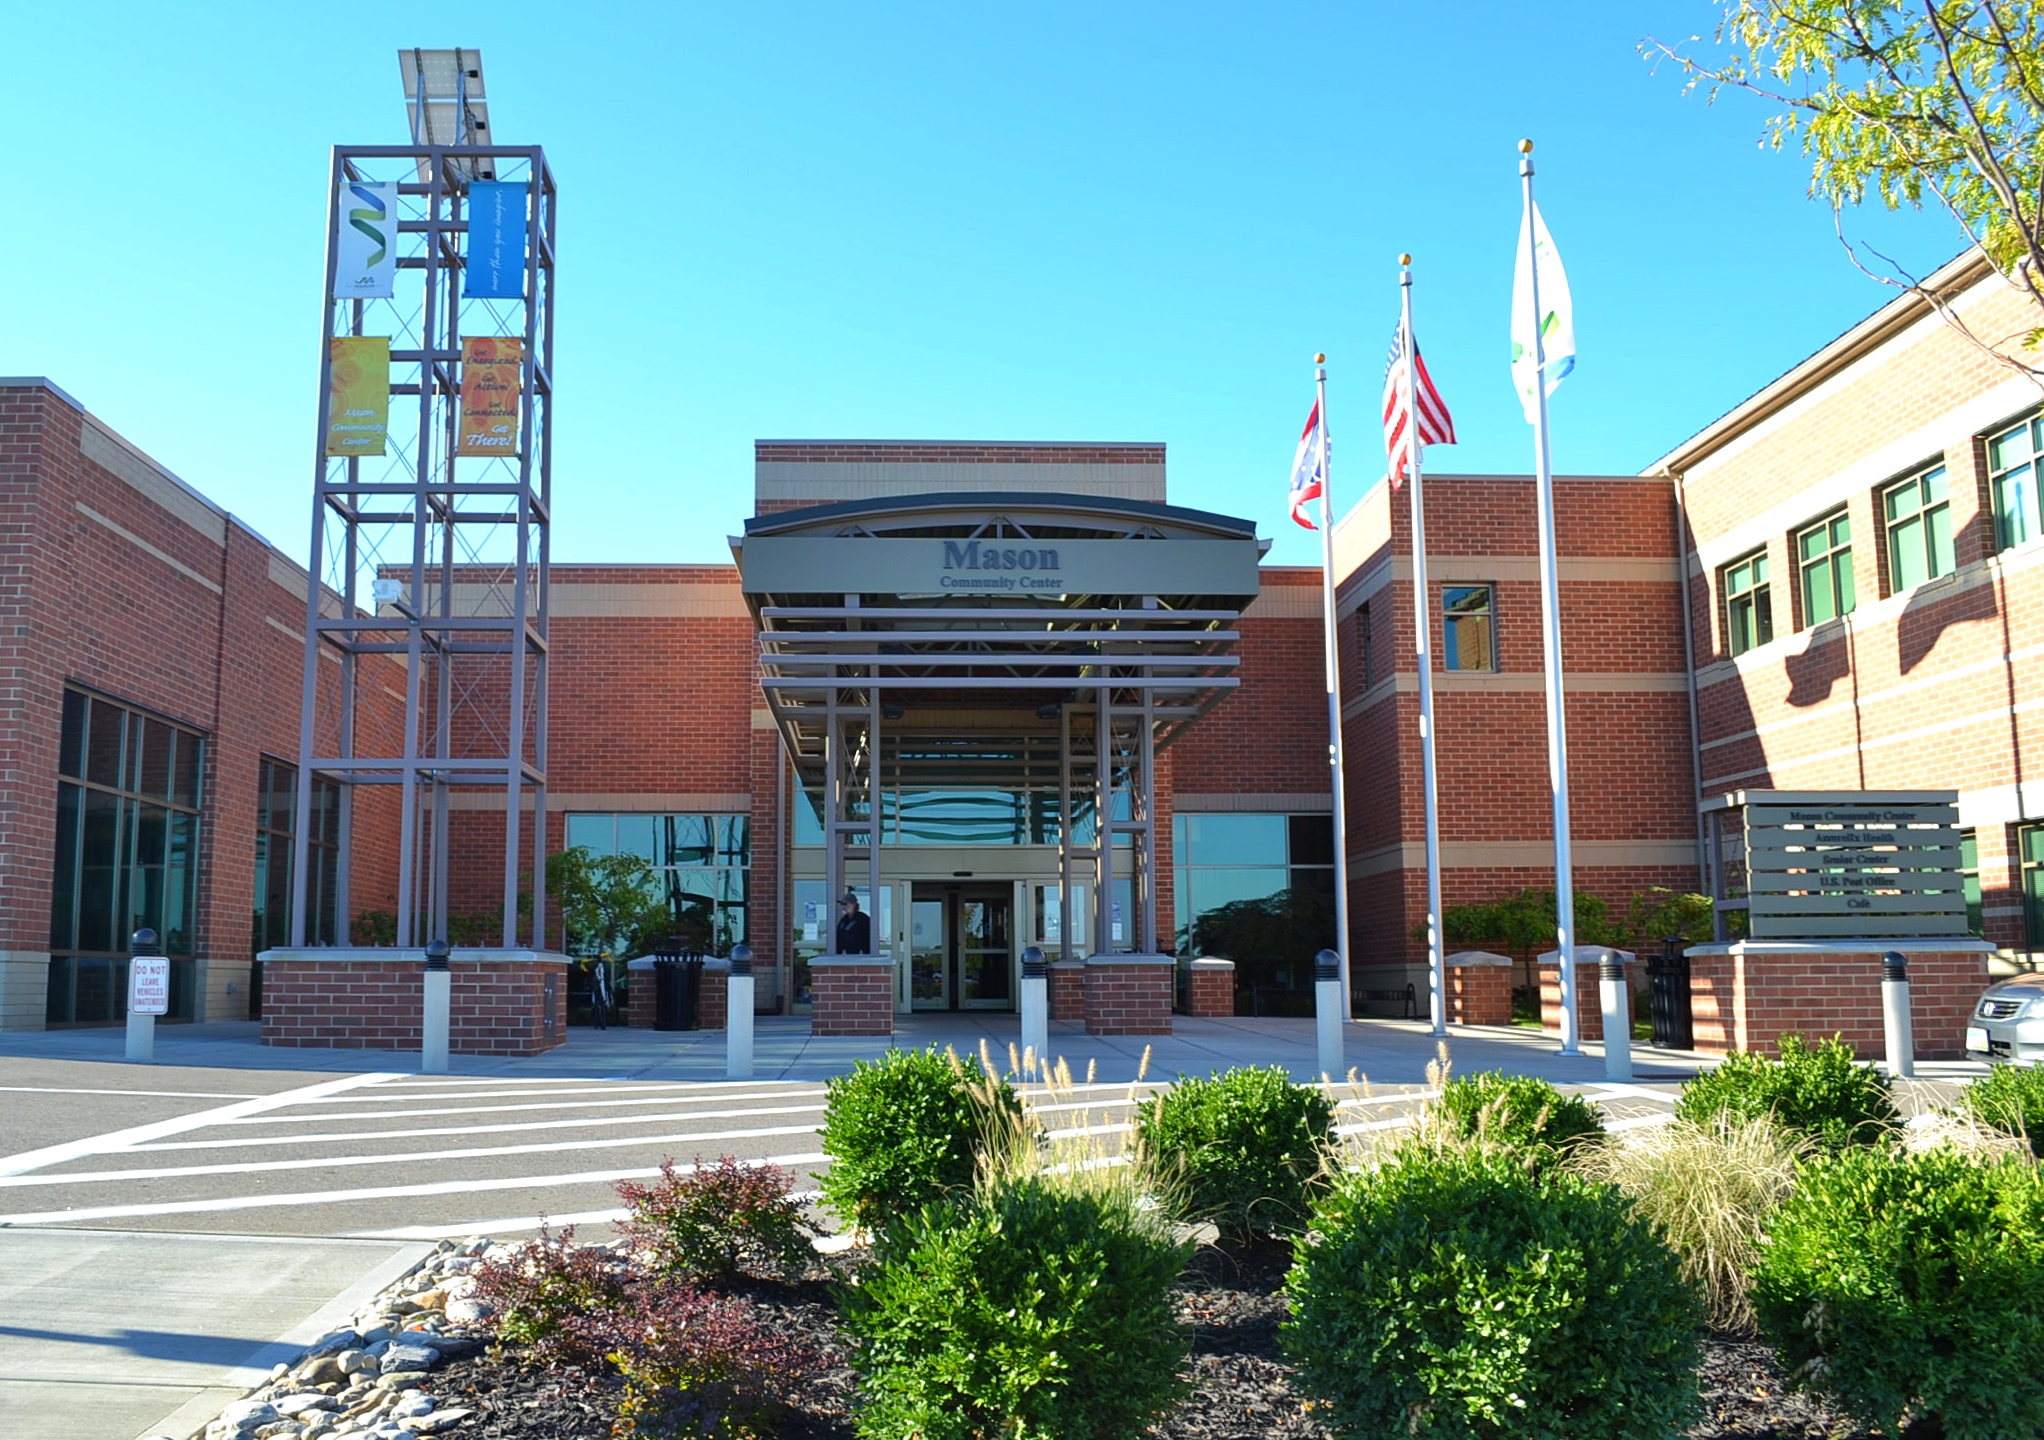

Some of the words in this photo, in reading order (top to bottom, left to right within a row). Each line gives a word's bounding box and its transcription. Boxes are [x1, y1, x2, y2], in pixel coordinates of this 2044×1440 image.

[494, 228, 506, 245] you
[344, 408, 376, 417] Mason
[332, 423, 385, 434] Community
[342, 437, 373, 446] Center
[466, 433, 514, 446] There!
[942, 540, 1061, 571] Mason
[939, 575, 1017, 591] Community
[1019, 576, 1063, 588] Center
[1790, 811, 1822, 821] Mason
[1825, 811, 1881, 823] Community
[1883, 811, 1917, 821] Center
[1862, 833, 1895, 843] Health
[1822, 855, 1854, 865] Senior
[1856, 855, 1890, 864] Center
[1820, 877, 1840, 886] U.S.
[1842, 877, 1864, 886] Post
[1865, 876, 1896, 886] Office
[136, 965, 147, 975] DO
[150, 965, 165, 975] NOT
[141, 978, 159, 986] LEAVE
[137, 988, 163, 996] VEHICLES
[134, 998, 165, 1006] UNATTENDED
